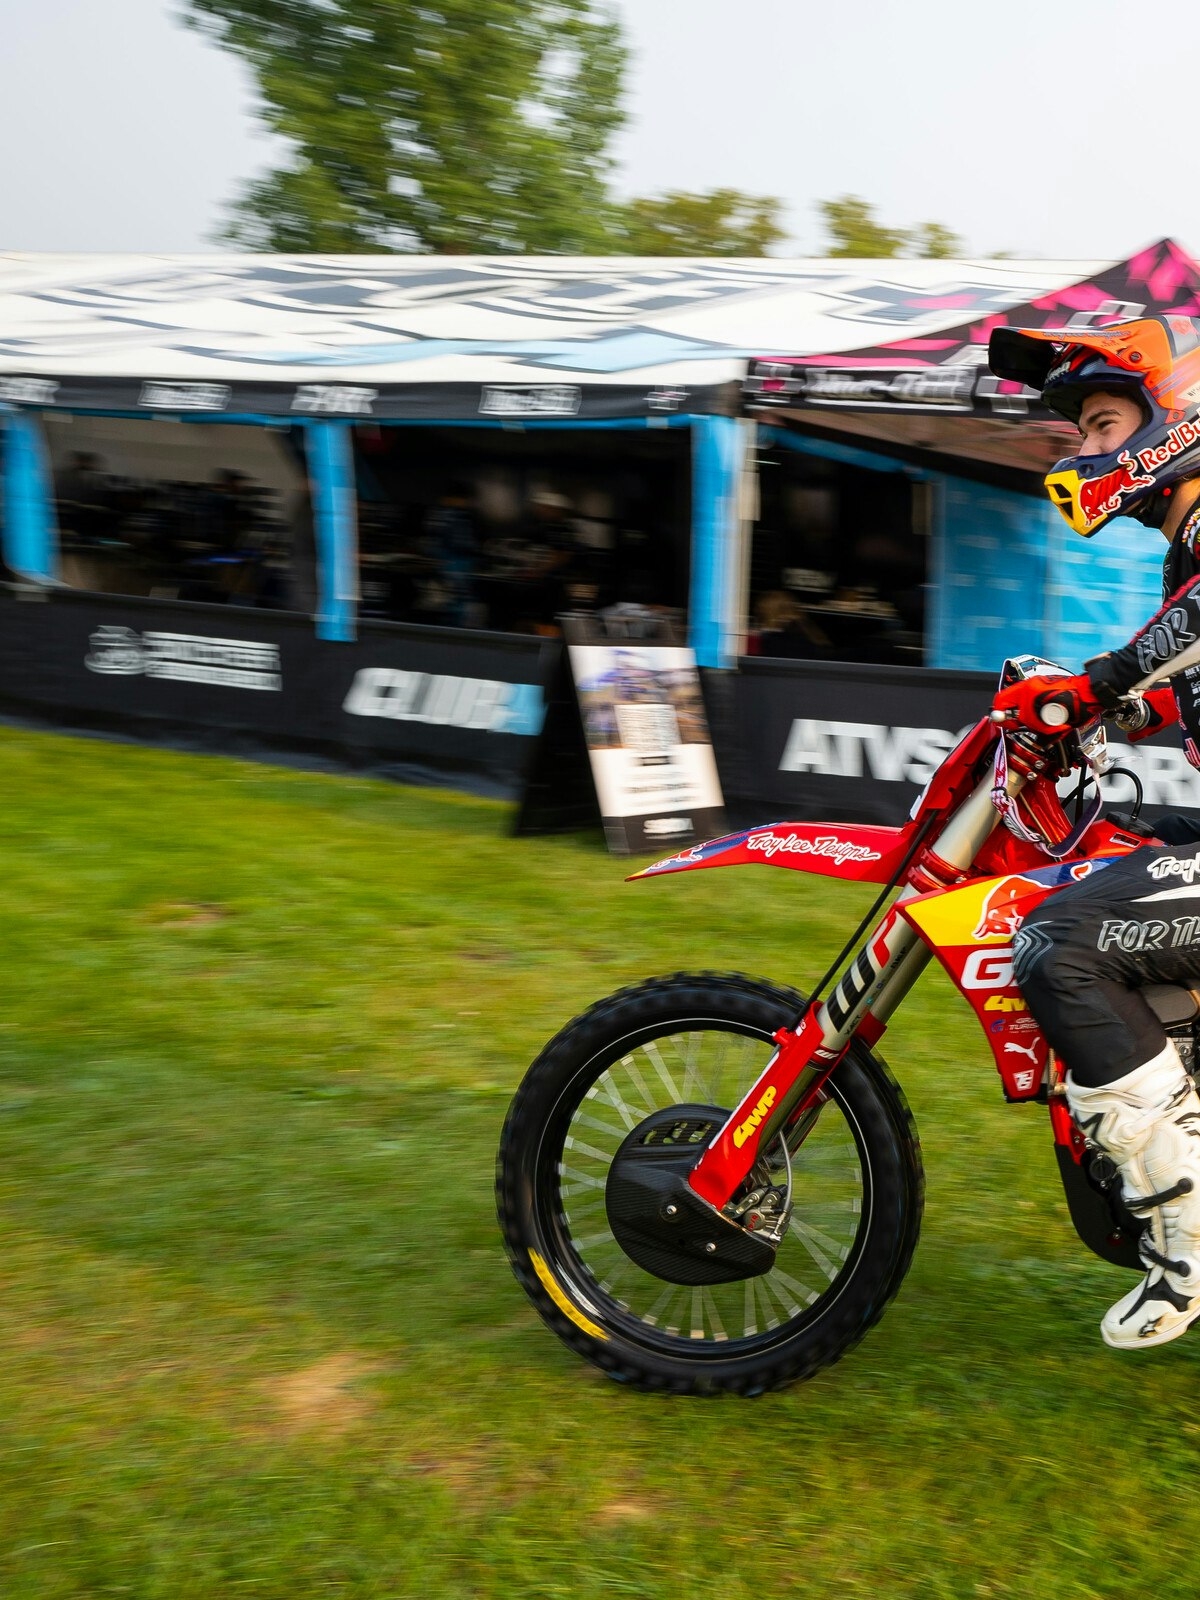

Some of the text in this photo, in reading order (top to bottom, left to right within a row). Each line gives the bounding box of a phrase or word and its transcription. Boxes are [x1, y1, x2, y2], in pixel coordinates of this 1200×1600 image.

[1138, 431, 1185, 472] Red
[747, 832, 882, 865] Troy Lee Designs
[1147, 854, 1195, 883] Troy
[1097, 919, 1170, 952] FOR
